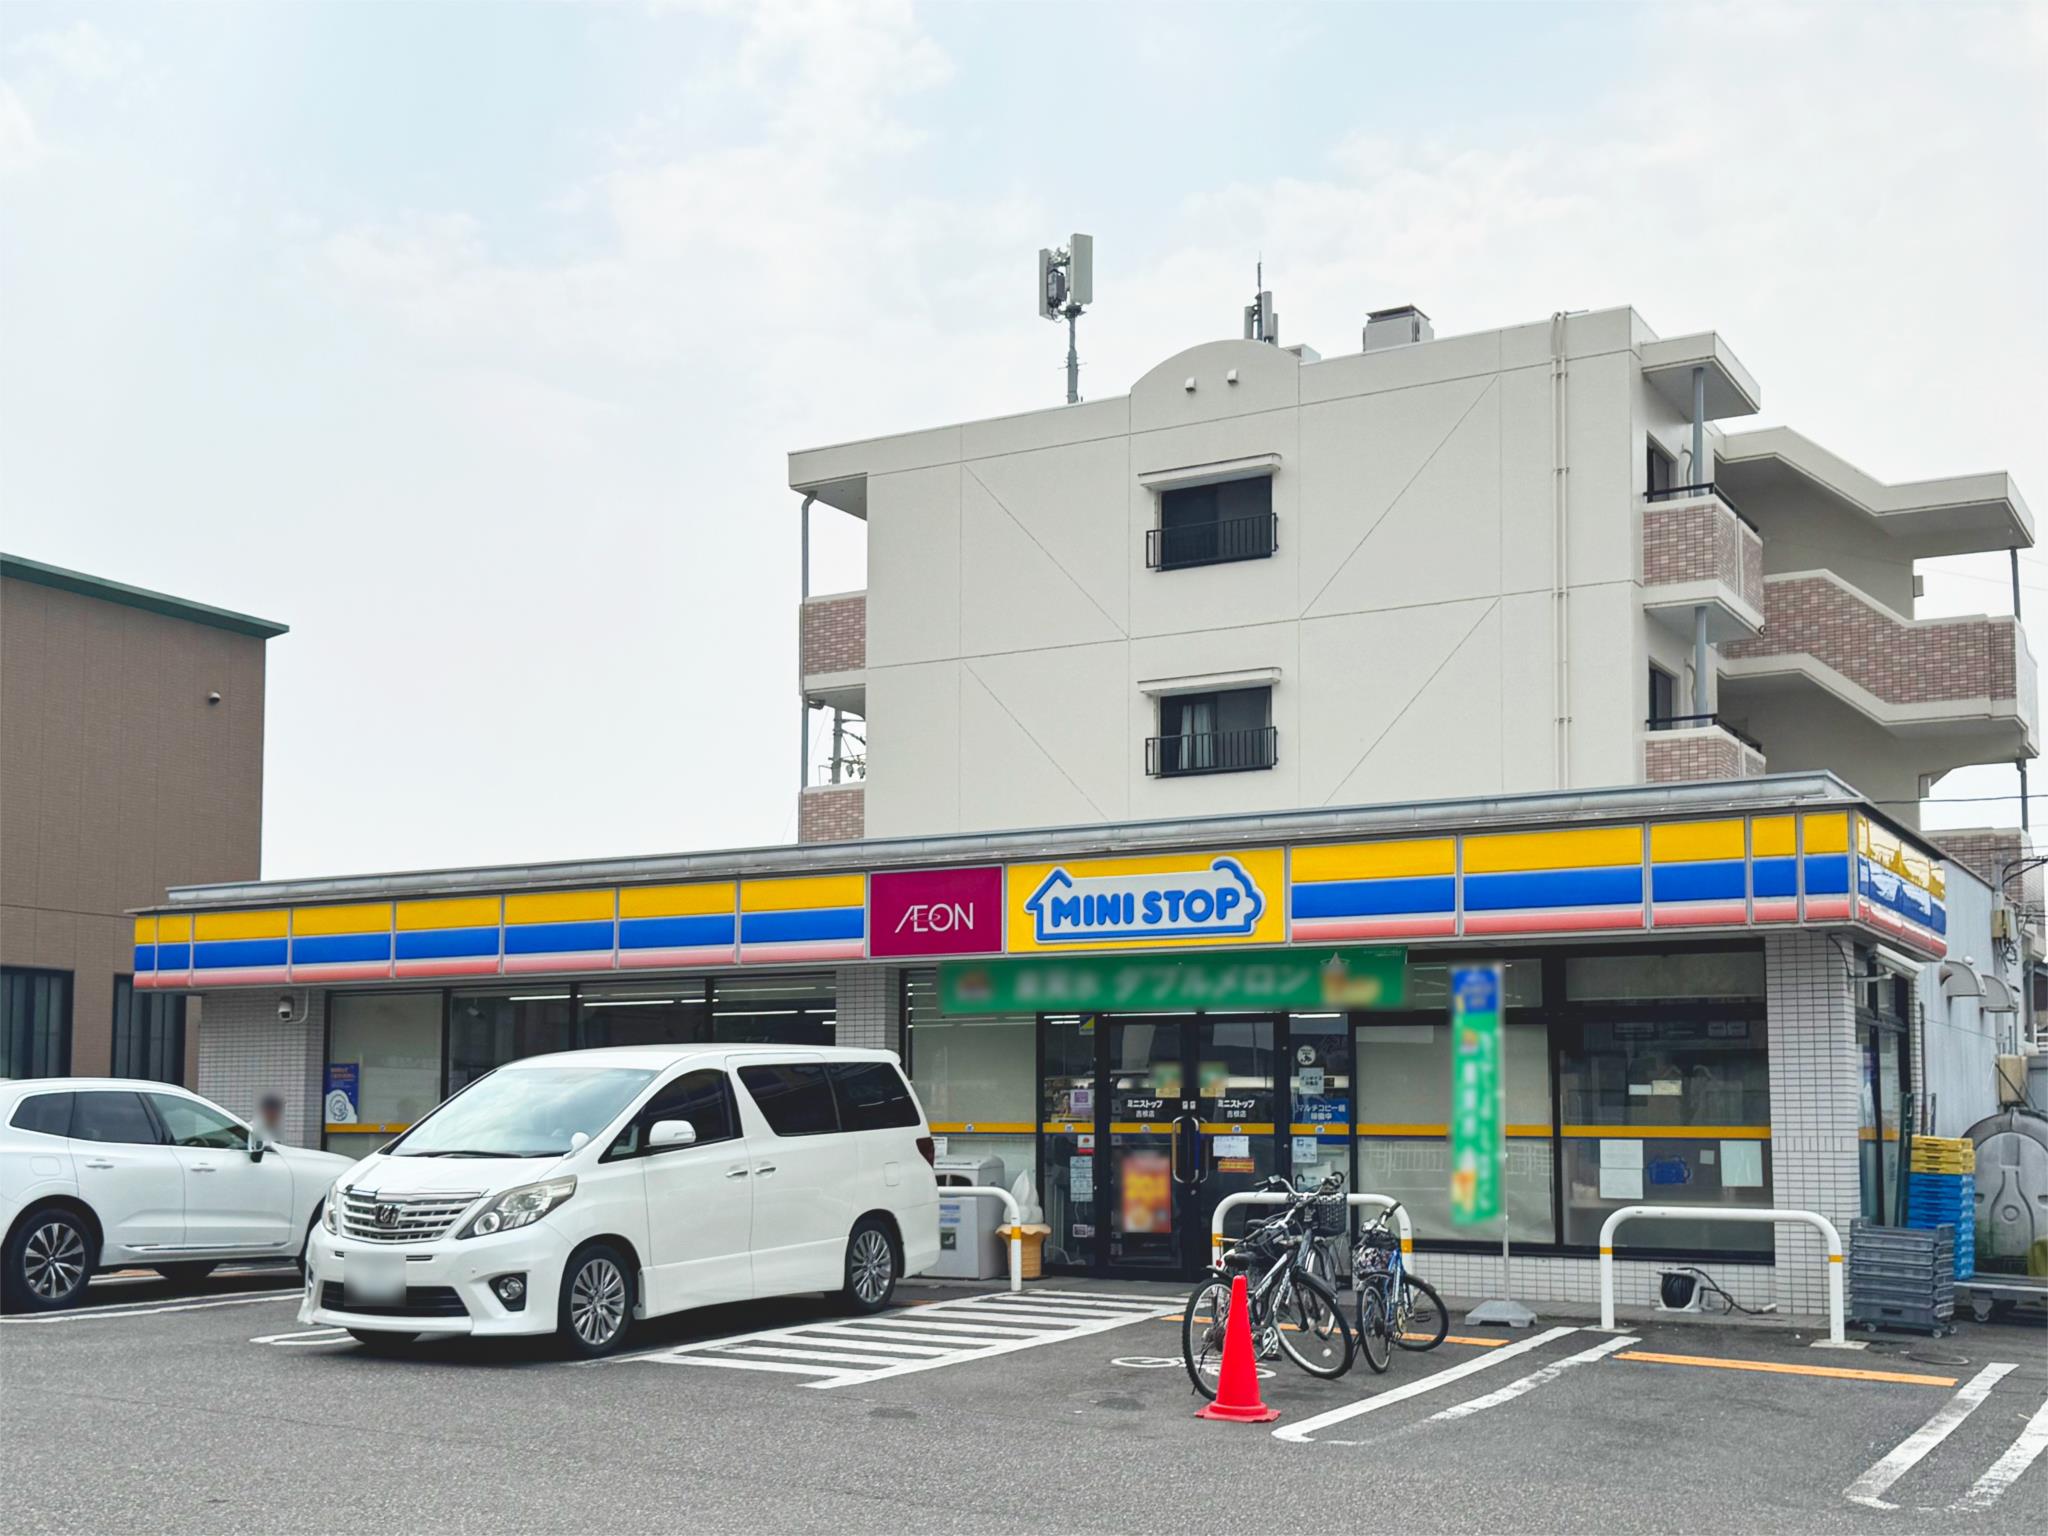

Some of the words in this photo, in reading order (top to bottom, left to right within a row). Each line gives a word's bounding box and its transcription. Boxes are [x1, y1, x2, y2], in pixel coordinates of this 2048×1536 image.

[1050, 892, 1135, 927] MINI
[1142, 887, 1240, 925] STOP
[1127, 1099, 1163, 1108] ミニストップ
[1217, 1099, 1256, 1108] ミニストップ
